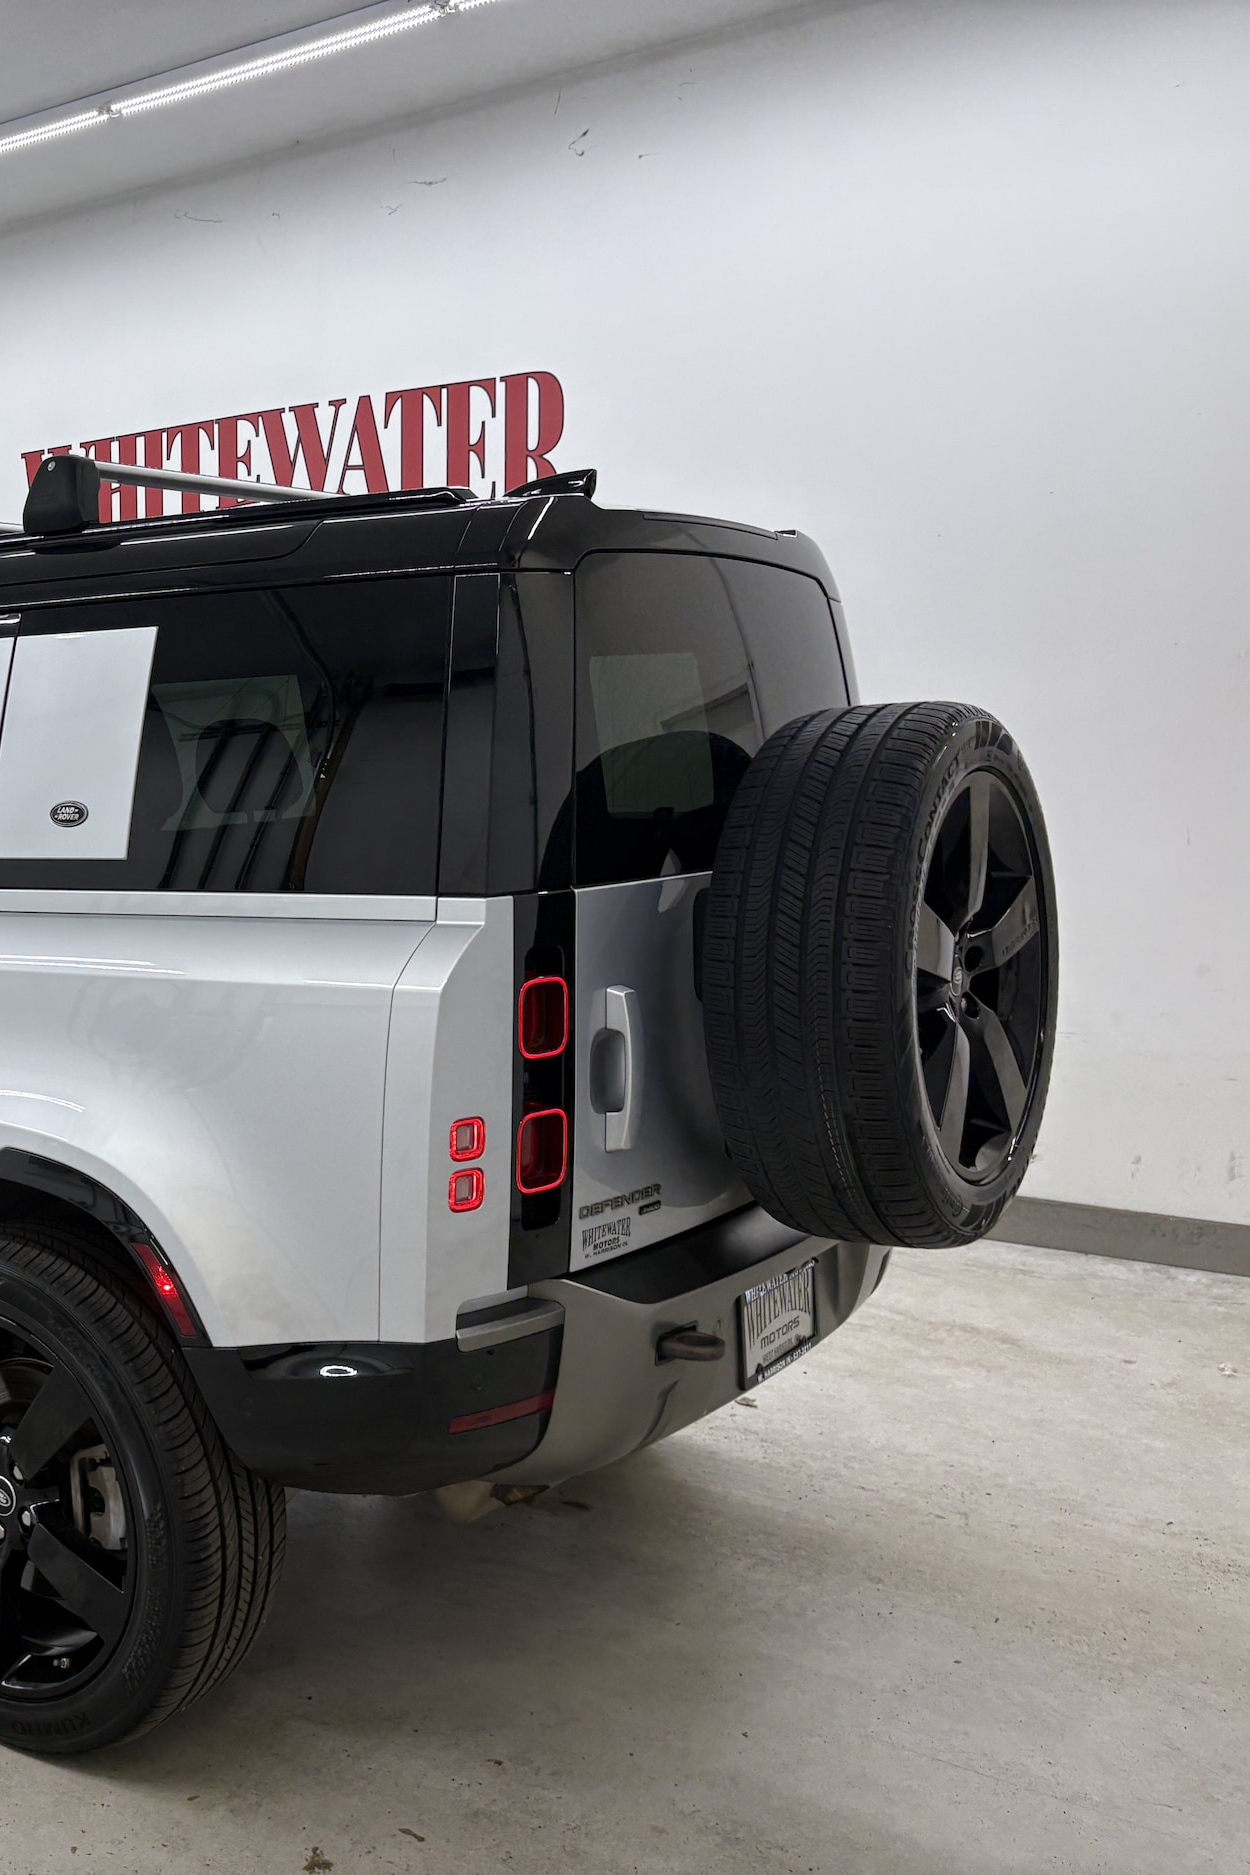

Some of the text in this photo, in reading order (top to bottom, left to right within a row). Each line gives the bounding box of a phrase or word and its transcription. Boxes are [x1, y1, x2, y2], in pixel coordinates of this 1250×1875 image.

[579, 1183, 662, 1220] DEFENDER
[582, 1216, 631, 1251] WHITEWATER
[593, 1236, 620, 1250] MOTORS
[745, 1266, 812, 1351] WHITEWATER
[760, 1315, 800, 1350] MOTORS
